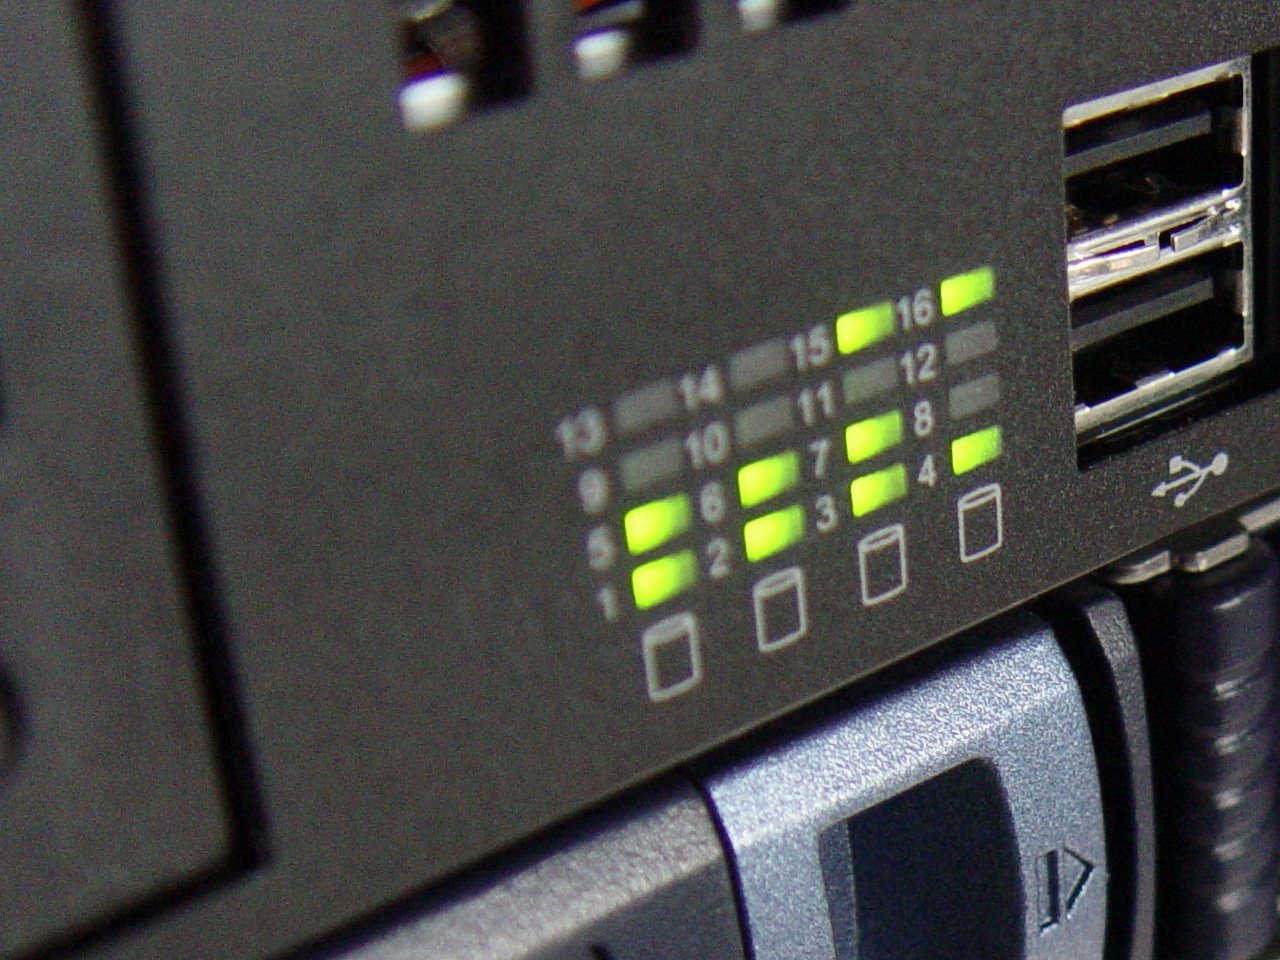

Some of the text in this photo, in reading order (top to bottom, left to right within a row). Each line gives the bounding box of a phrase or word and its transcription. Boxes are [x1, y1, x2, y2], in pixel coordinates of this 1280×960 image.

[680, 364, 724, 408] 14
[790, 324, 831, 370] 15
[898, 288, 934, 330] 16
[686, 420, 729, 468] 10
[799, 382, 834, 424] 11
[900, 343, 938, 383] 12
[702, 481, 725, 523] 6
[810, 439, 831, 479] 7
[914, 400, 933, 436] 8
[598, 454, 937, 622] 1 2 3 4
